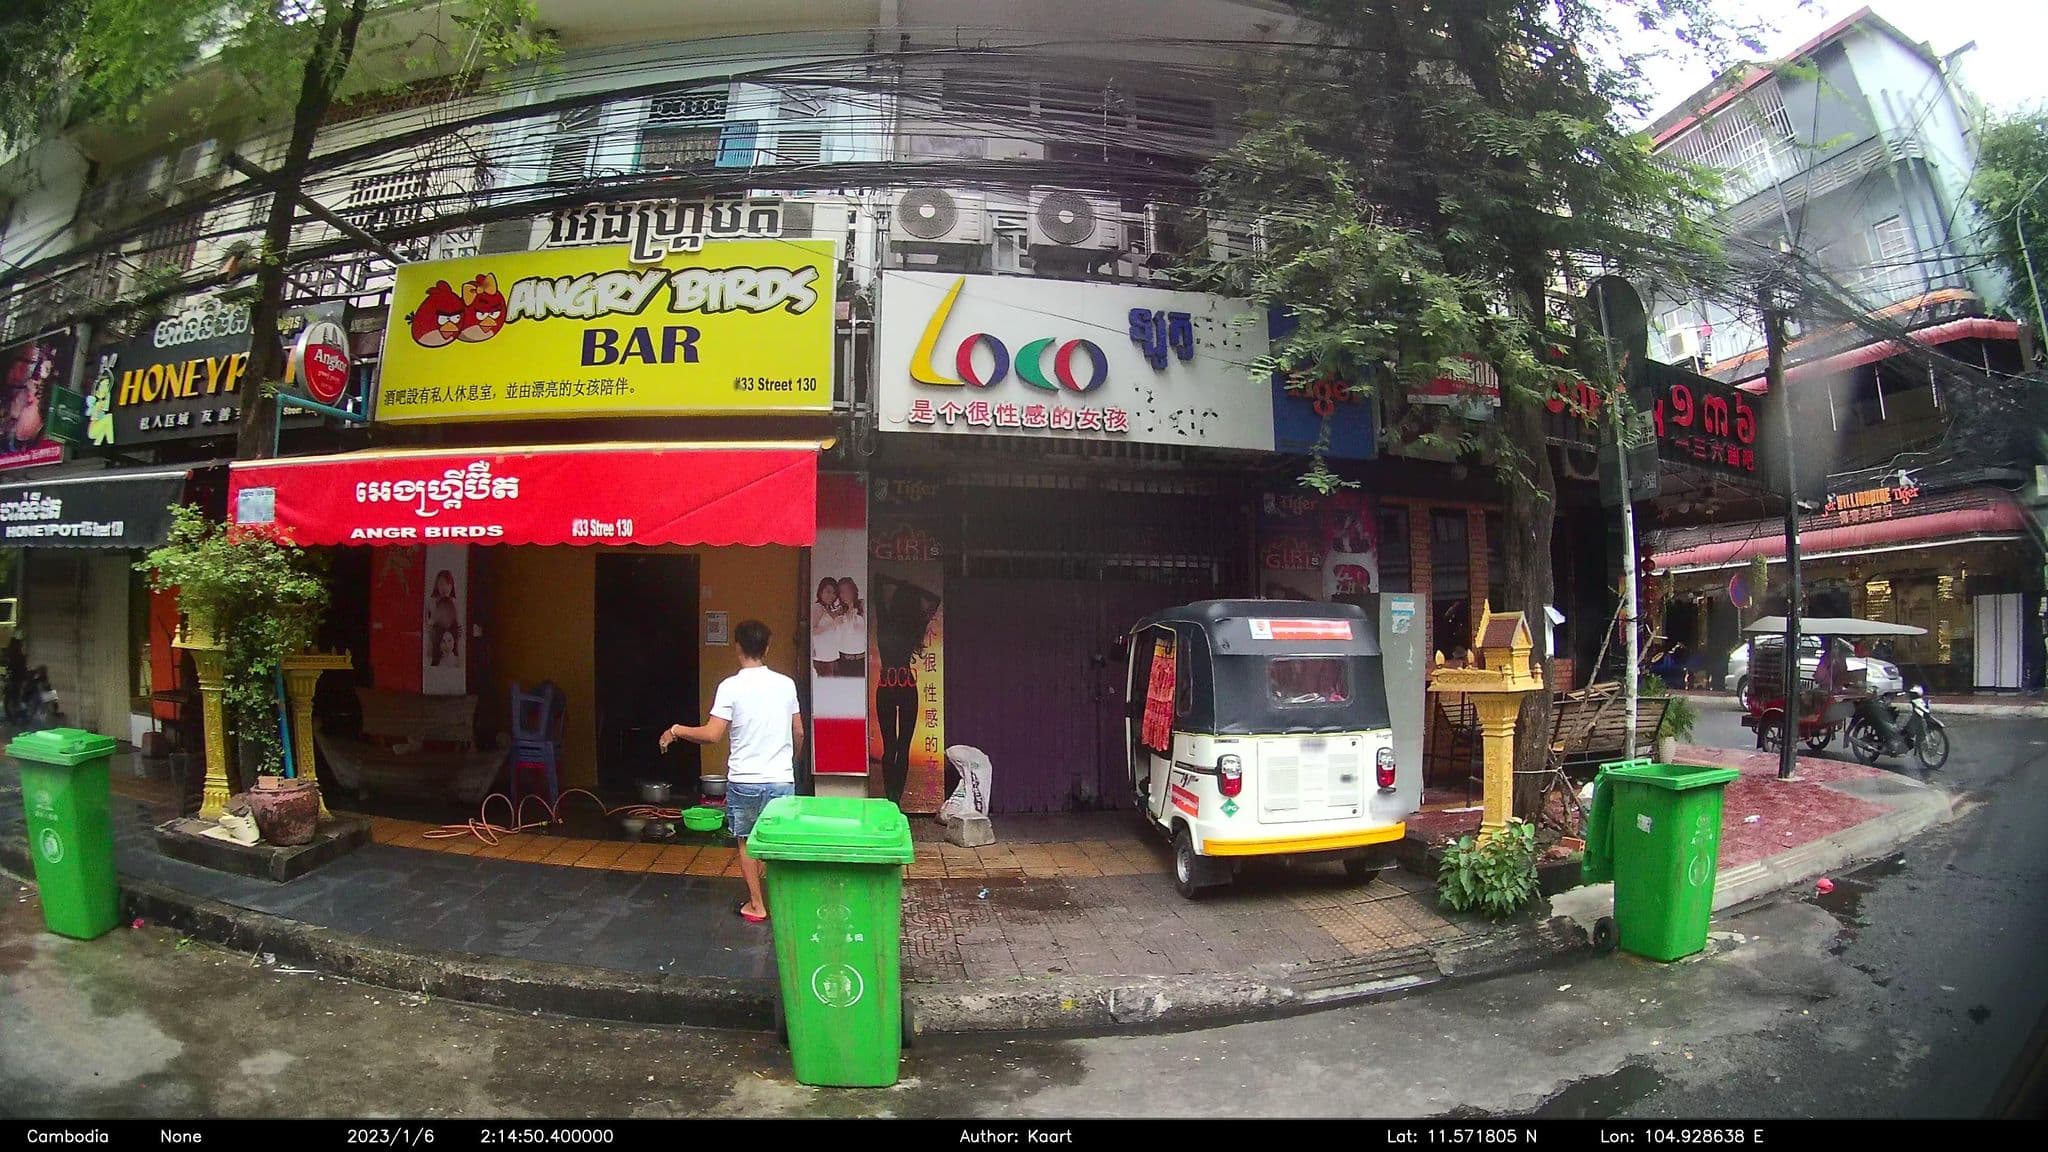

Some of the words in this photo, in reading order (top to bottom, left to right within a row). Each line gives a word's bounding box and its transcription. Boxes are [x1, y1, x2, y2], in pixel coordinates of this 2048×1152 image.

[506, 267, 671, 323] ANGRY
[671, 265, 819, 315] BIRDS
[580, 325, 701, 367] BAR
[313, 348, 347, 372] Angkor
[117, 346, 299, 406] HONEYPT
[757, 376, 793, 392] Street
[796, 376, 817, 391] 130
[909, 399, 1129, 432] 是个很性感的女孩
[1892, 487, 1920, 505] Tiger
[350, 527, 418, 539] ANGR
[425, 525, 504, 539] BIRDS
[615, 518, 633, 537] 130
[878, 667, 917, 688] LOCO
